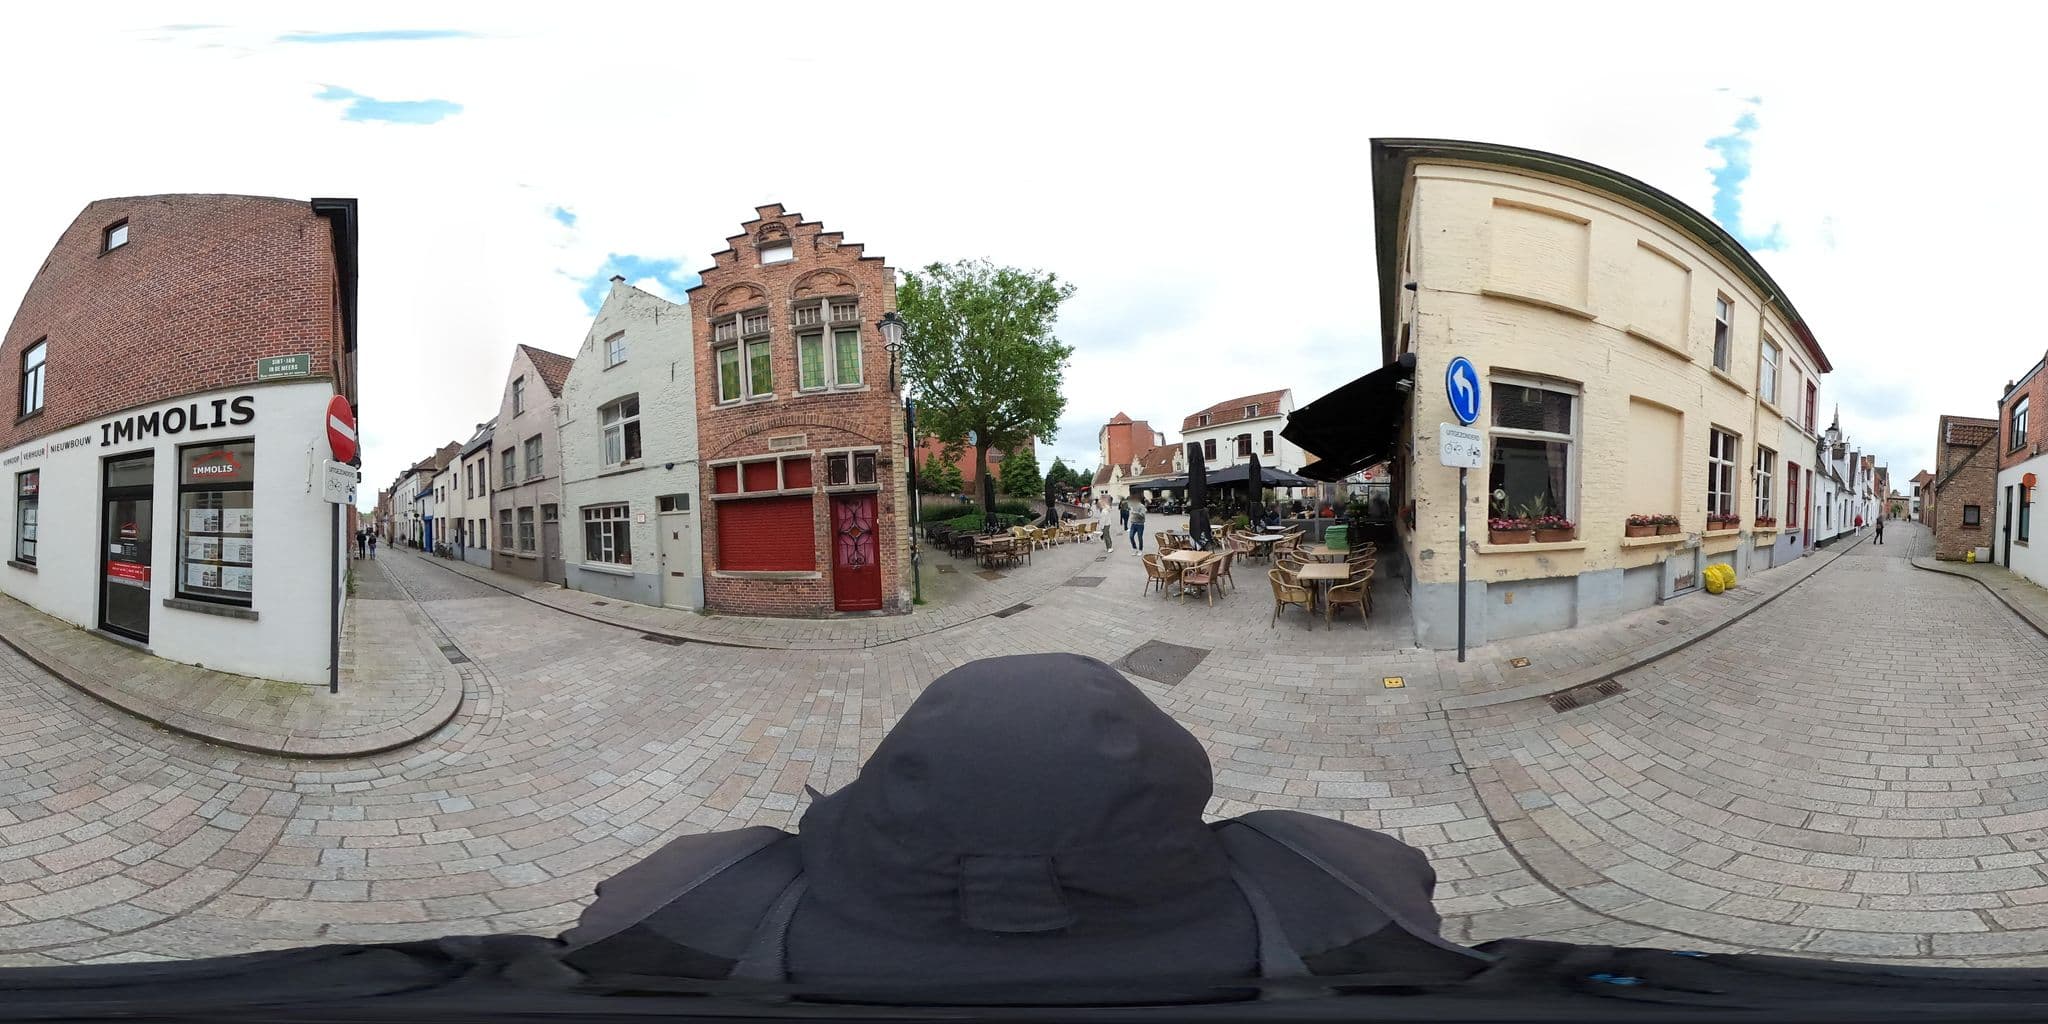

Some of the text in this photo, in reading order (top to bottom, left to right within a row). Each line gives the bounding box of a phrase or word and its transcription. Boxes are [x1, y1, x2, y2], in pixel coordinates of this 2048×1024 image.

[101, 395, 255, 447] IMMOLIS
[23, 447, 45, 461] VERHUUR
[50, 435, 92, 453] NIEUWBOUW
[192, 464, 233, 475] IMMOLIS
